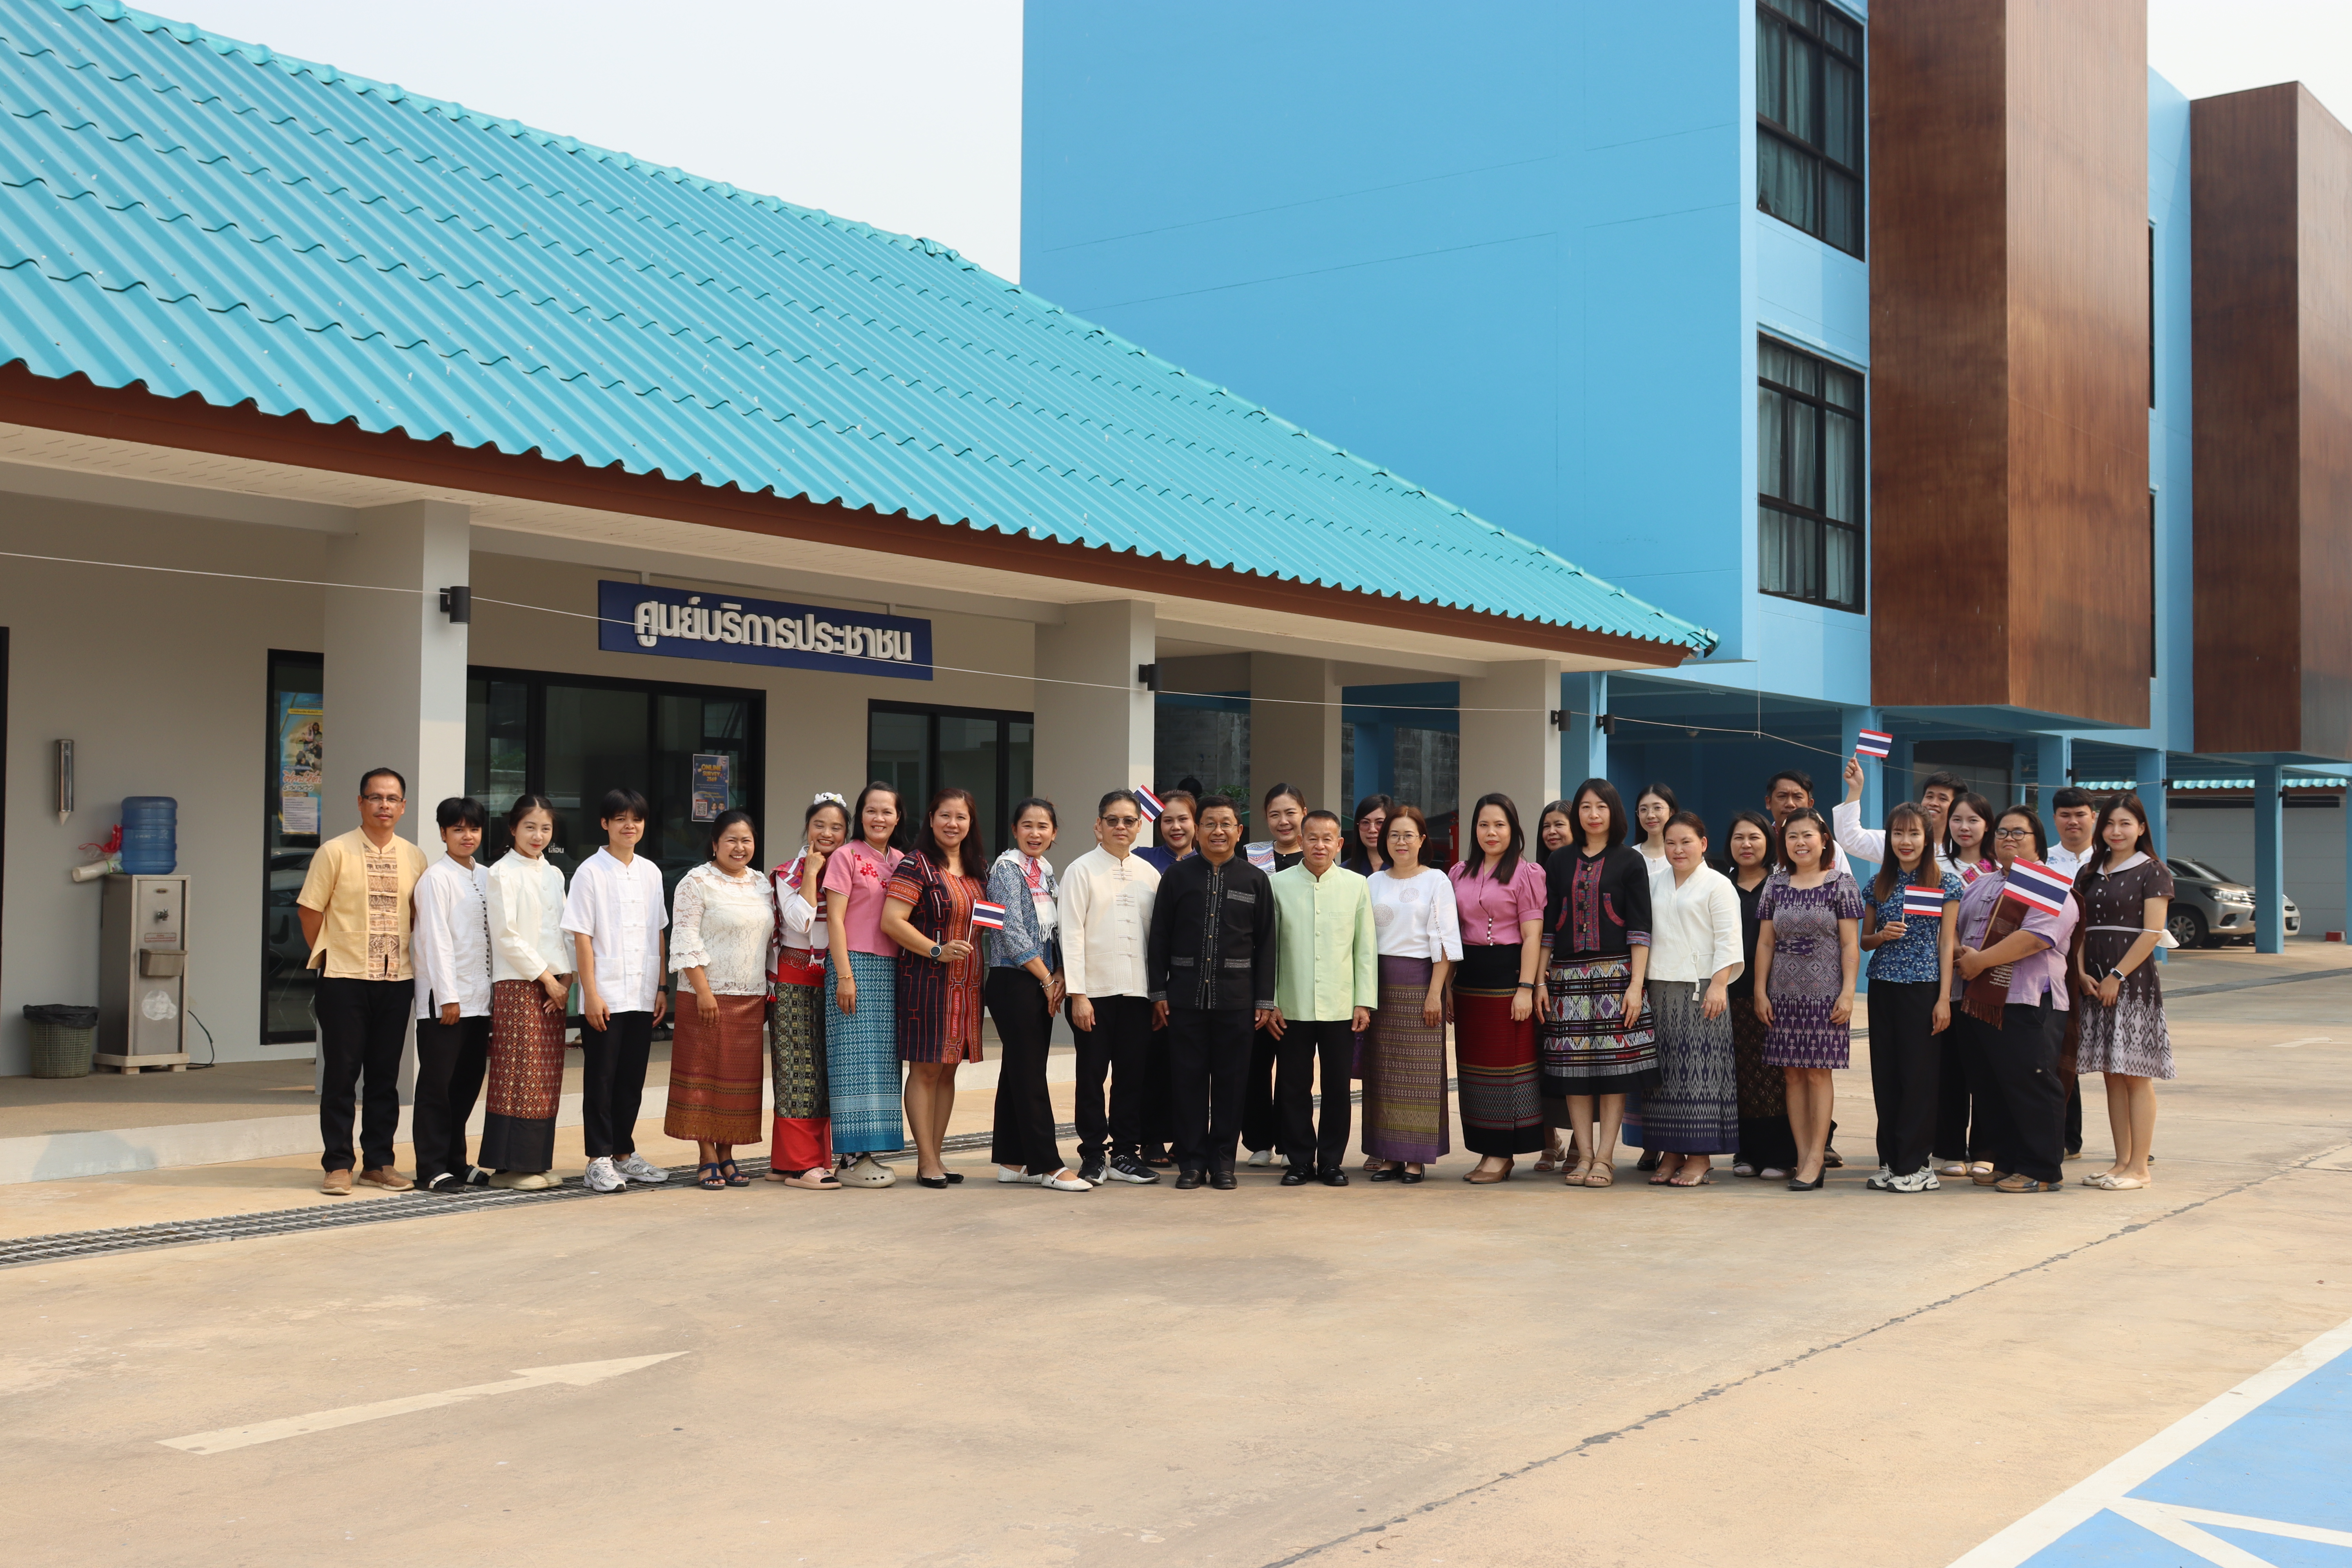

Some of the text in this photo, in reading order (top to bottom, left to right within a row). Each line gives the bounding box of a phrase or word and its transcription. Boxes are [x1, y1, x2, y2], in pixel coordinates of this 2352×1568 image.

[635, 596, 912, 661] ศูนย์บริการประชาชน
